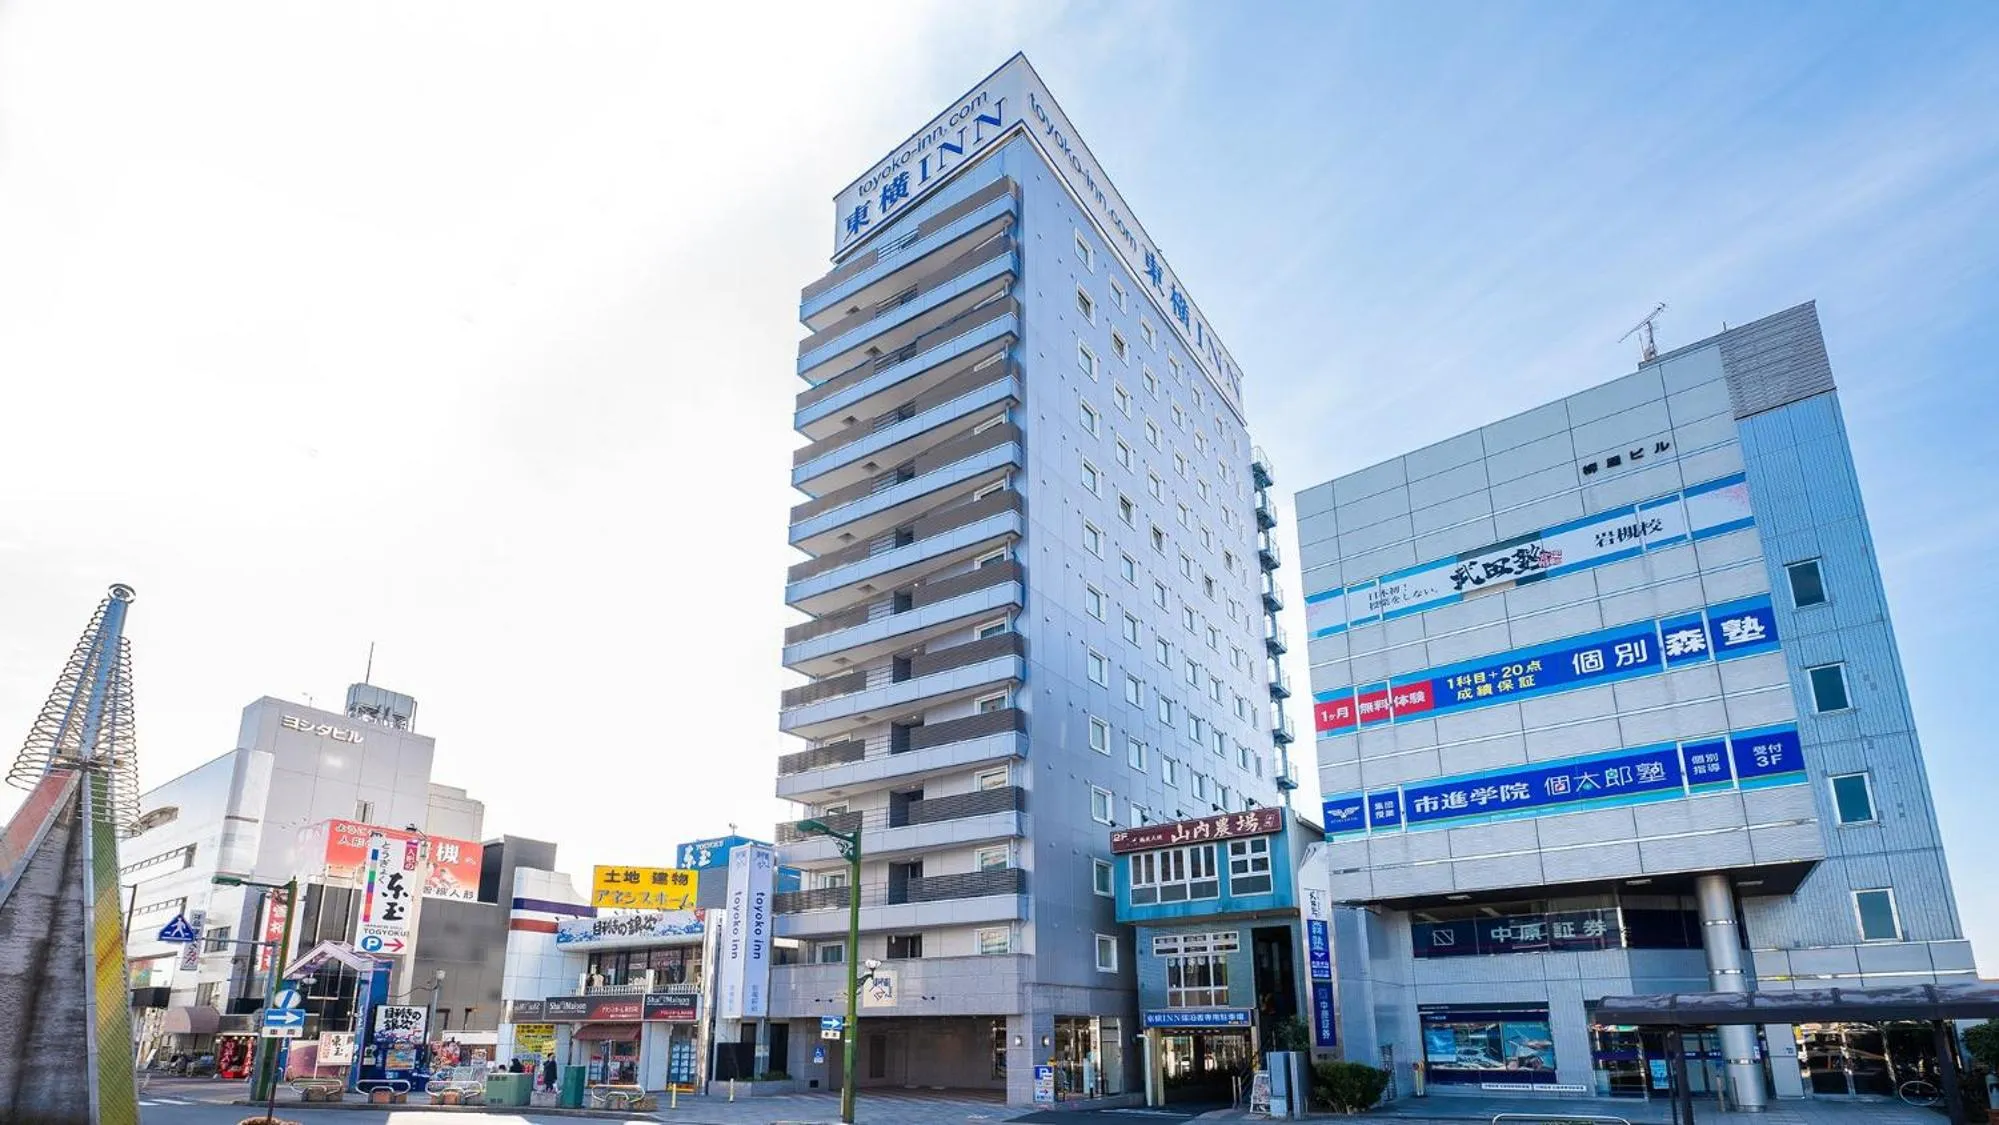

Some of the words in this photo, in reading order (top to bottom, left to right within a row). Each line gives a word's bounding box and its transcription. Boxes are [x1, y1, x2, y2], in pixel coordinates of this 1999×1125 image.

[858, 91, 988, 197] toyoko-inn.com
[843, 97, 1008, 242] 東横INN
[1029, 92, 1139, 252] toyoko-inn.com
[1142, 241, 1241, 400] 東横INN
[1595, 517, 1664, 548] 岩槻校
[1572, 638, 1648, 675] 個別
[1665, 616, 1767, 656] 森塾
[1359, 690, 1427, 715] 無料体験
[1457, 675, 1537, 701] 成績保証
[281, 714, 364, 744] ヨシダビル
[1691, 752, 1719, 764] 個別
[1753, 743, 1783, 756] 受付
[1757, 755, 1783, 768] 3F
[1693, 764, 1722, 775] 指導
[1414, 781, 1531, 814] 市進学院
[1544, 761, 1667, 797] 個太郎塾
[1171, 813, 1261, 843] 山内農場
[604, 869, 640, 884] 土地
[652, 871, 689, 886] 建物
[731, 892, 742, 935] toyoko
[754, 892, 766, 936] toyoko
[1491, 919, 1607, 943] 中原証券
[753, 940, 765, 960] inn
